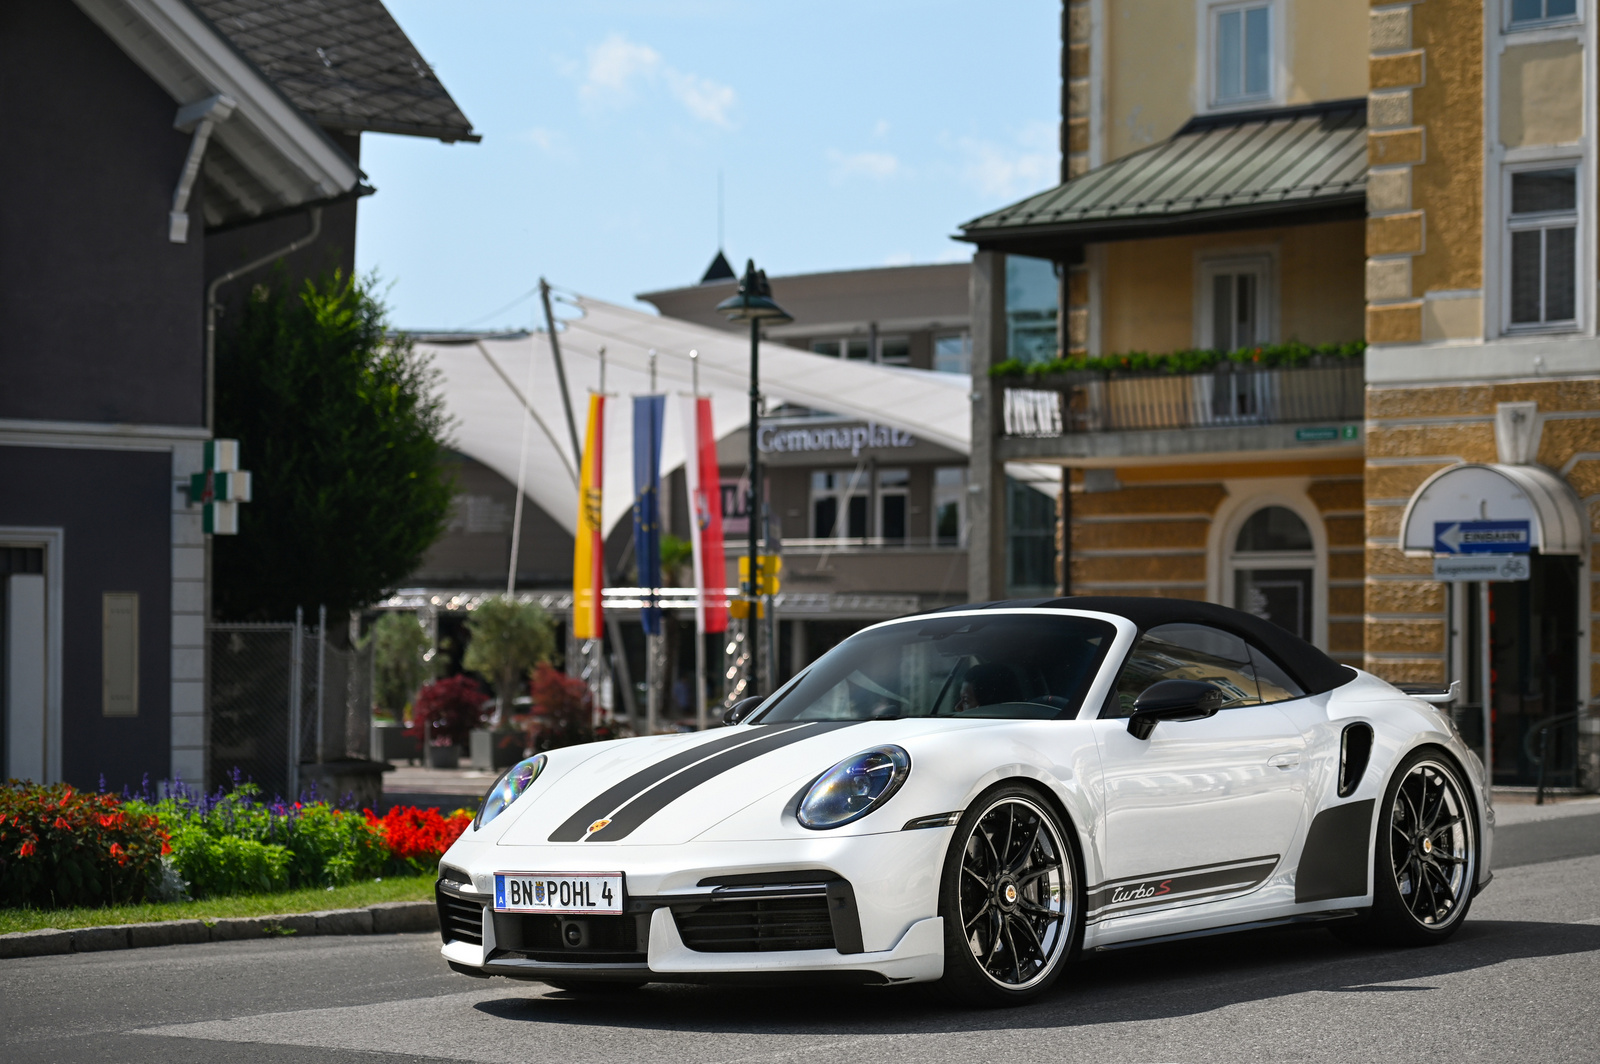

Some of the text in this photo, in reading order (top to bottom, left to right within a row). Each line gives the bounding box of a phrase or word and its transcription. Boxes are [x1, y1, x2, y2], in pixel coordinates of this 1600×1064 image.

[757, 421, 914, 457] Gemonaplatz
[1464, 532, 1519, 543] EINBAHN
[498, 896, 504, 904] A
[510, 880, 613, 907] BN POHL 4
[1112, 880, 1172, 903] turbo S
